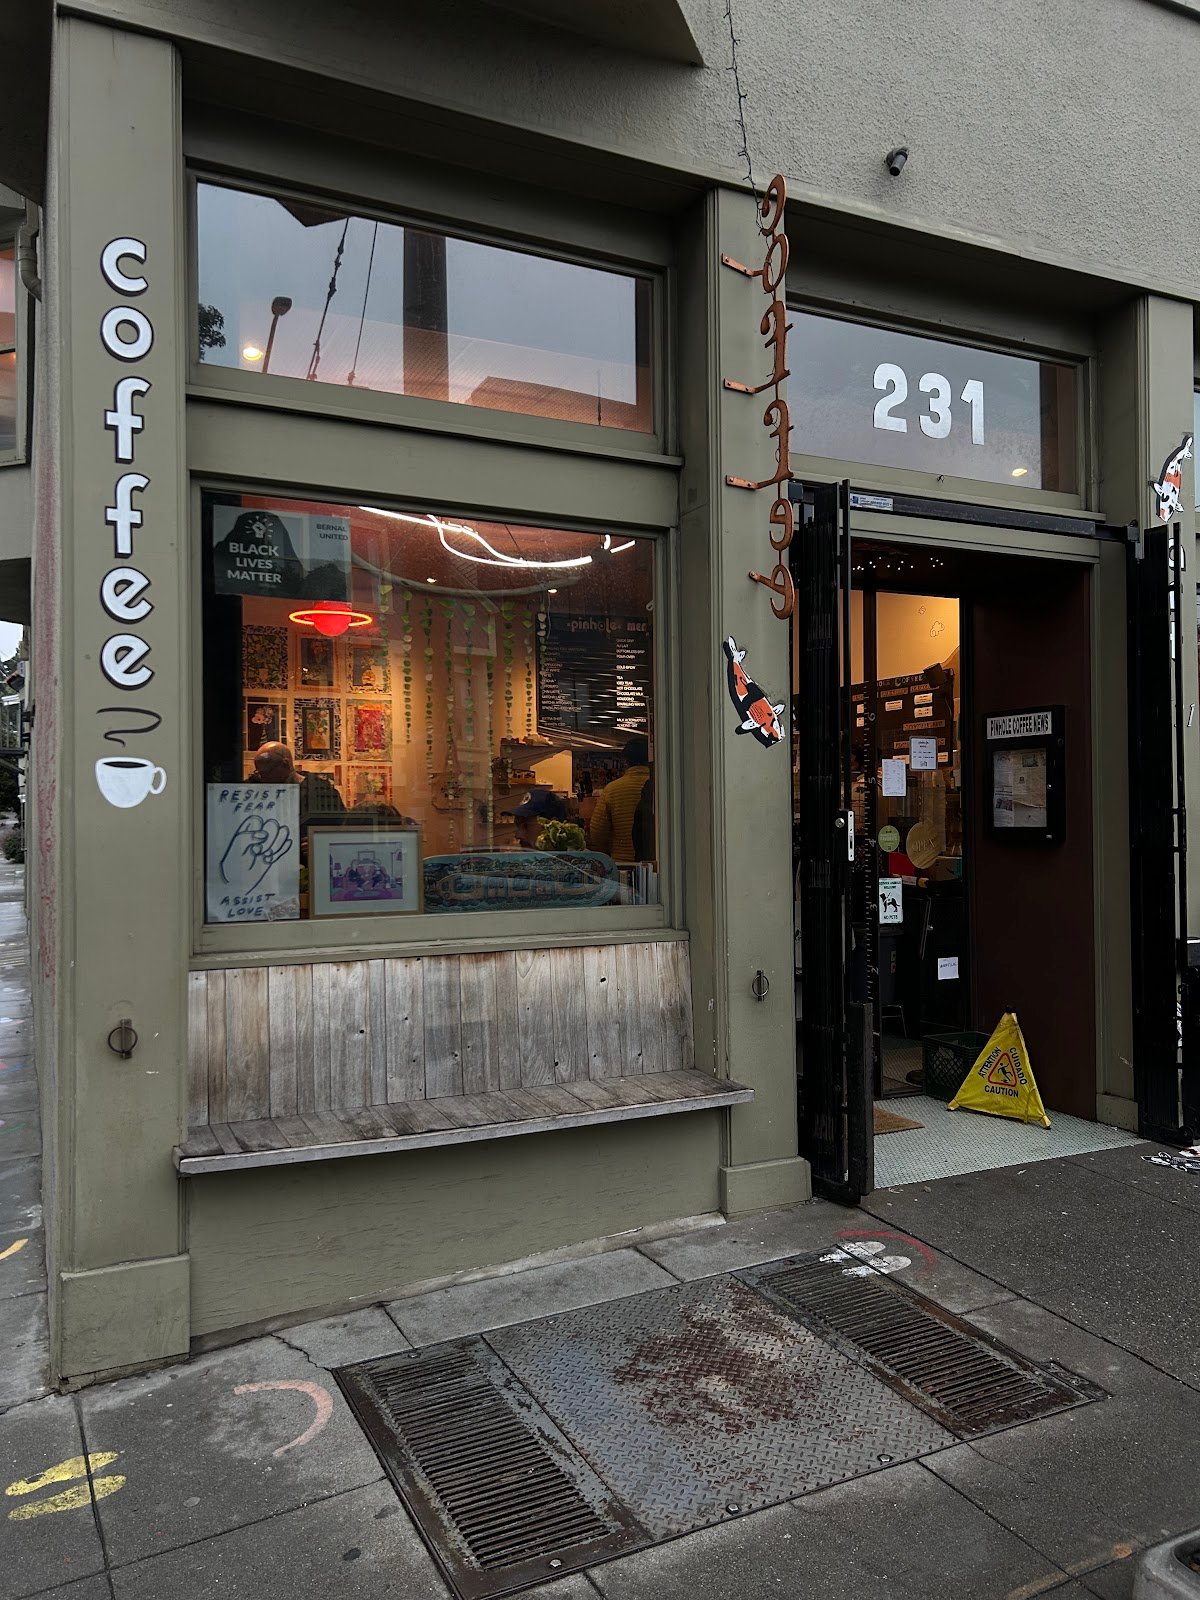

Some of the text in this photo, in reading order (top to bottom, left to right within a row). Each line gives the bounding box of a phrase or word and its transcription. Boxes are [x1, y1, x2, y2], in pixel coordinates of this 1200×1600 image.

[872, 362, 985, 446] 231
[100, 237, 154, 691] coffee
[316, 523, 348, 532] BERNAL
[319, 533, 349, 541] UNITED
[229, 542, 280, 557] BLACK
[236, 557, 273, 569] LIVES
[227, 570, 282, 584] MATTER
[990, 713, 1049, 737] PINHOLE COFFEE NEWS
[220, 789, 287, 802] RESIST
[234, 801, 276, 813] FEAR
[220, 893, 276, 906] ASSIST
[227, 907, 264, 918] LOVE
[978, 1047, 1002, 1078] ATTENTION
[1010, 1047, 1028, 1085] CUIDADO
[984, 1084, 1019, 1098] CAUTION
